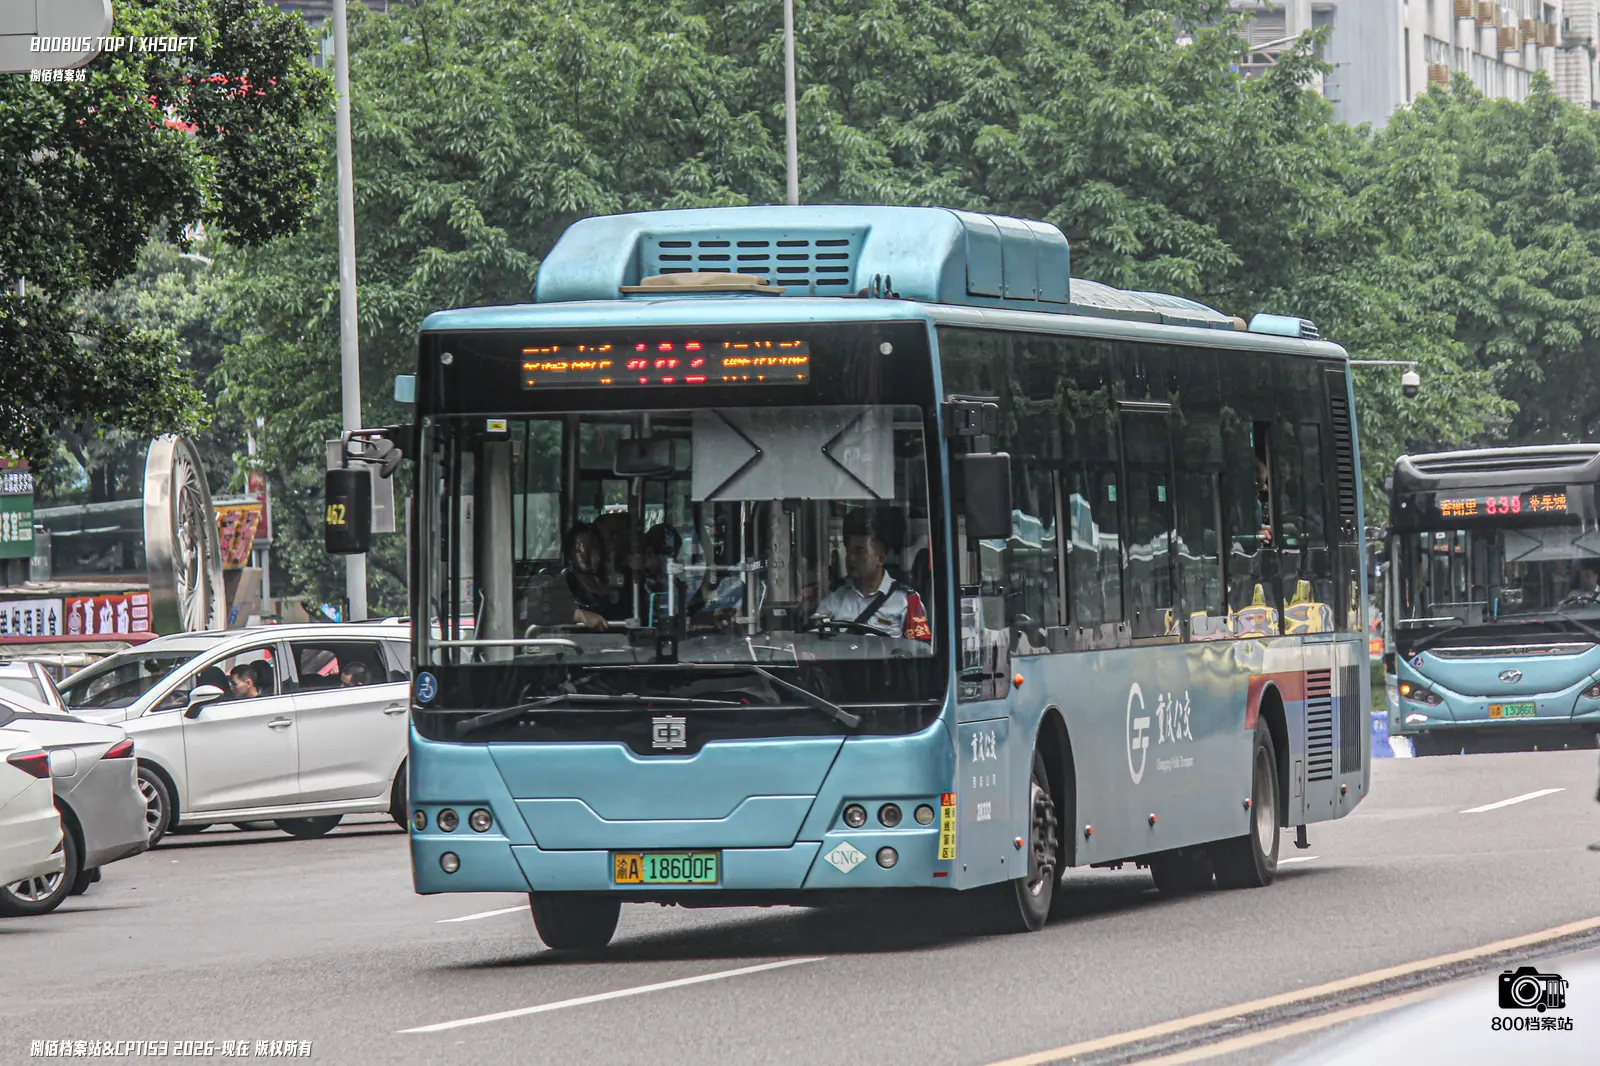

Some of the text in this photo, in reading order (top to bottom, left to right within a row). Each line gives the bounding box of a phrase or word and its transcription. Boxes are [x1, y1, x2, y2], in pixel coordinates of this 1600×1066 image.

[1155, 689, 1193, 745] 重庆公交
[831, 850, 859, 865] CNG
